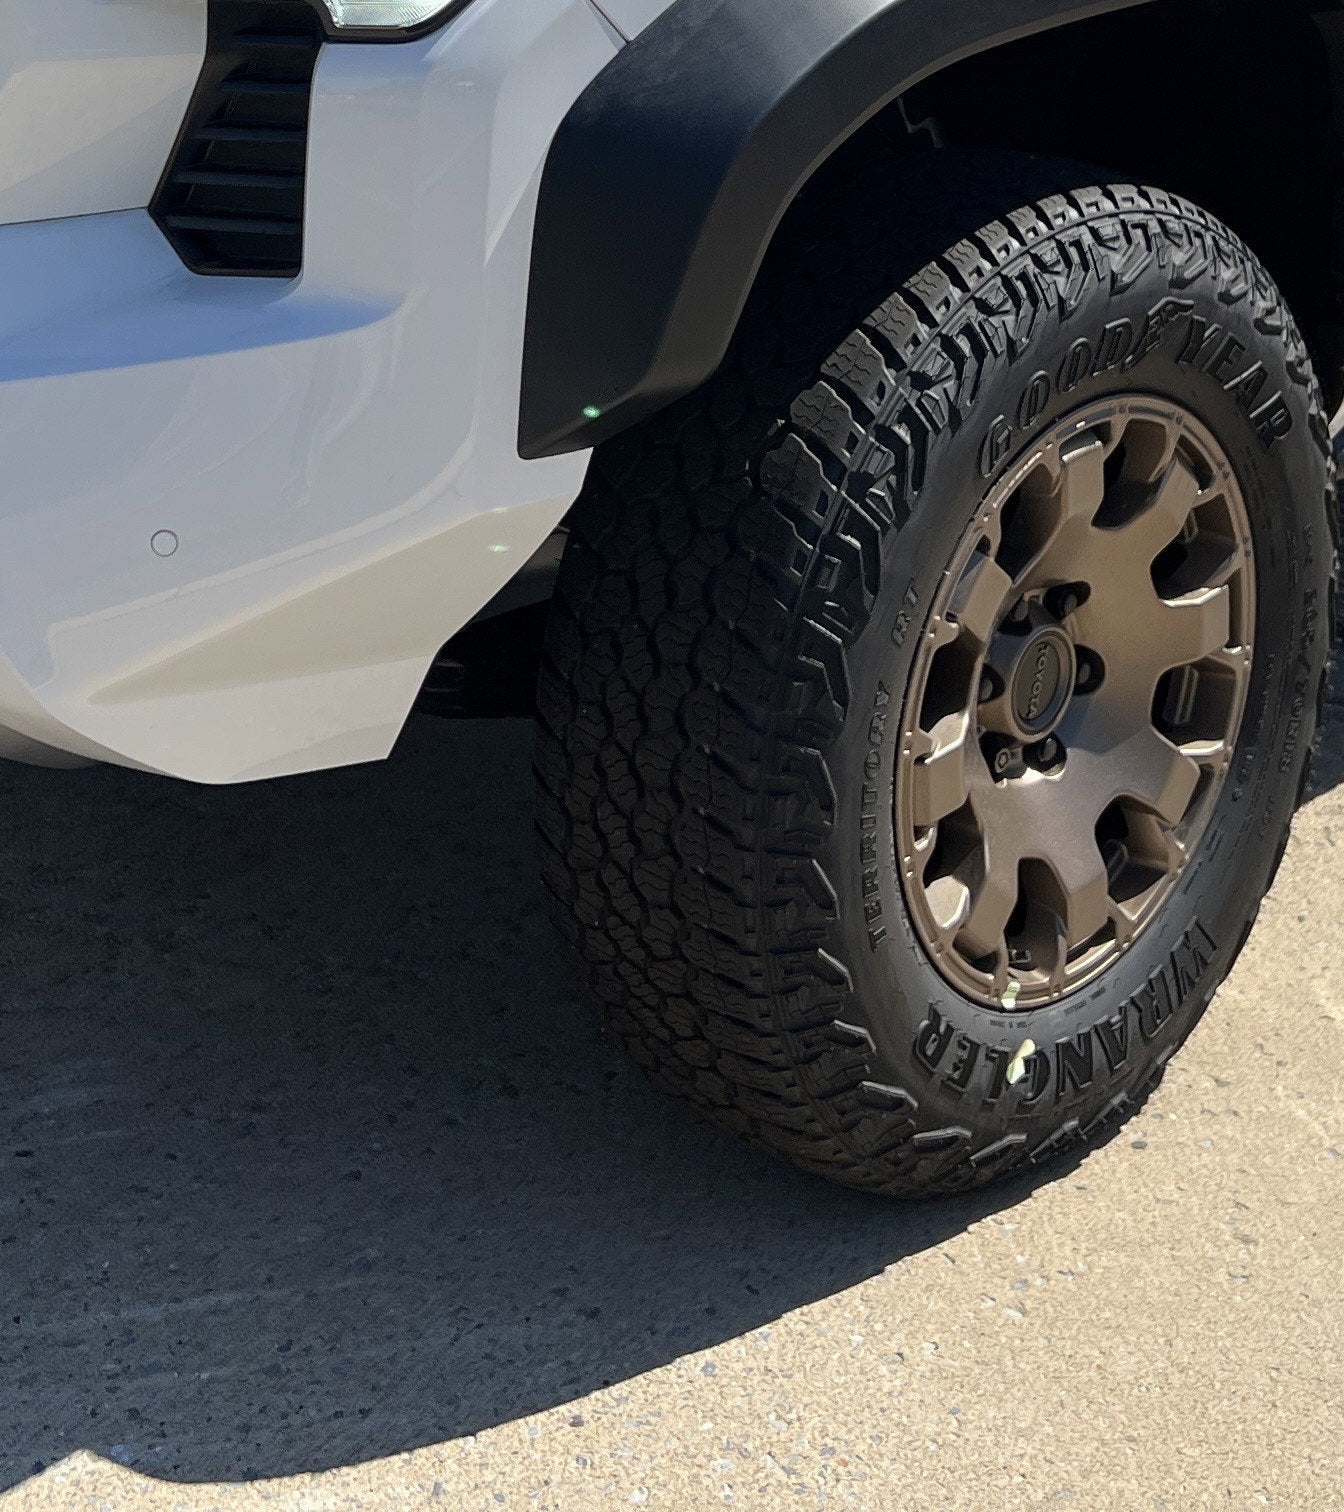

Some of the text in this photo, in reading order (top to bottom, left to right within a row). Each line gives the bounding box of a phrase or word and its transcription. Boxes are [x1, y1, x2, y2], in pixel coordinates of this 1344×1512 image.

[977, 296, 1294, 480] GOODYEAR
[859, 579, 919, 952] TERRITORY RT
[1027, 640, 1050, 720] TOYOTA
[913, 914, 1218, 1106] WRANGLER
